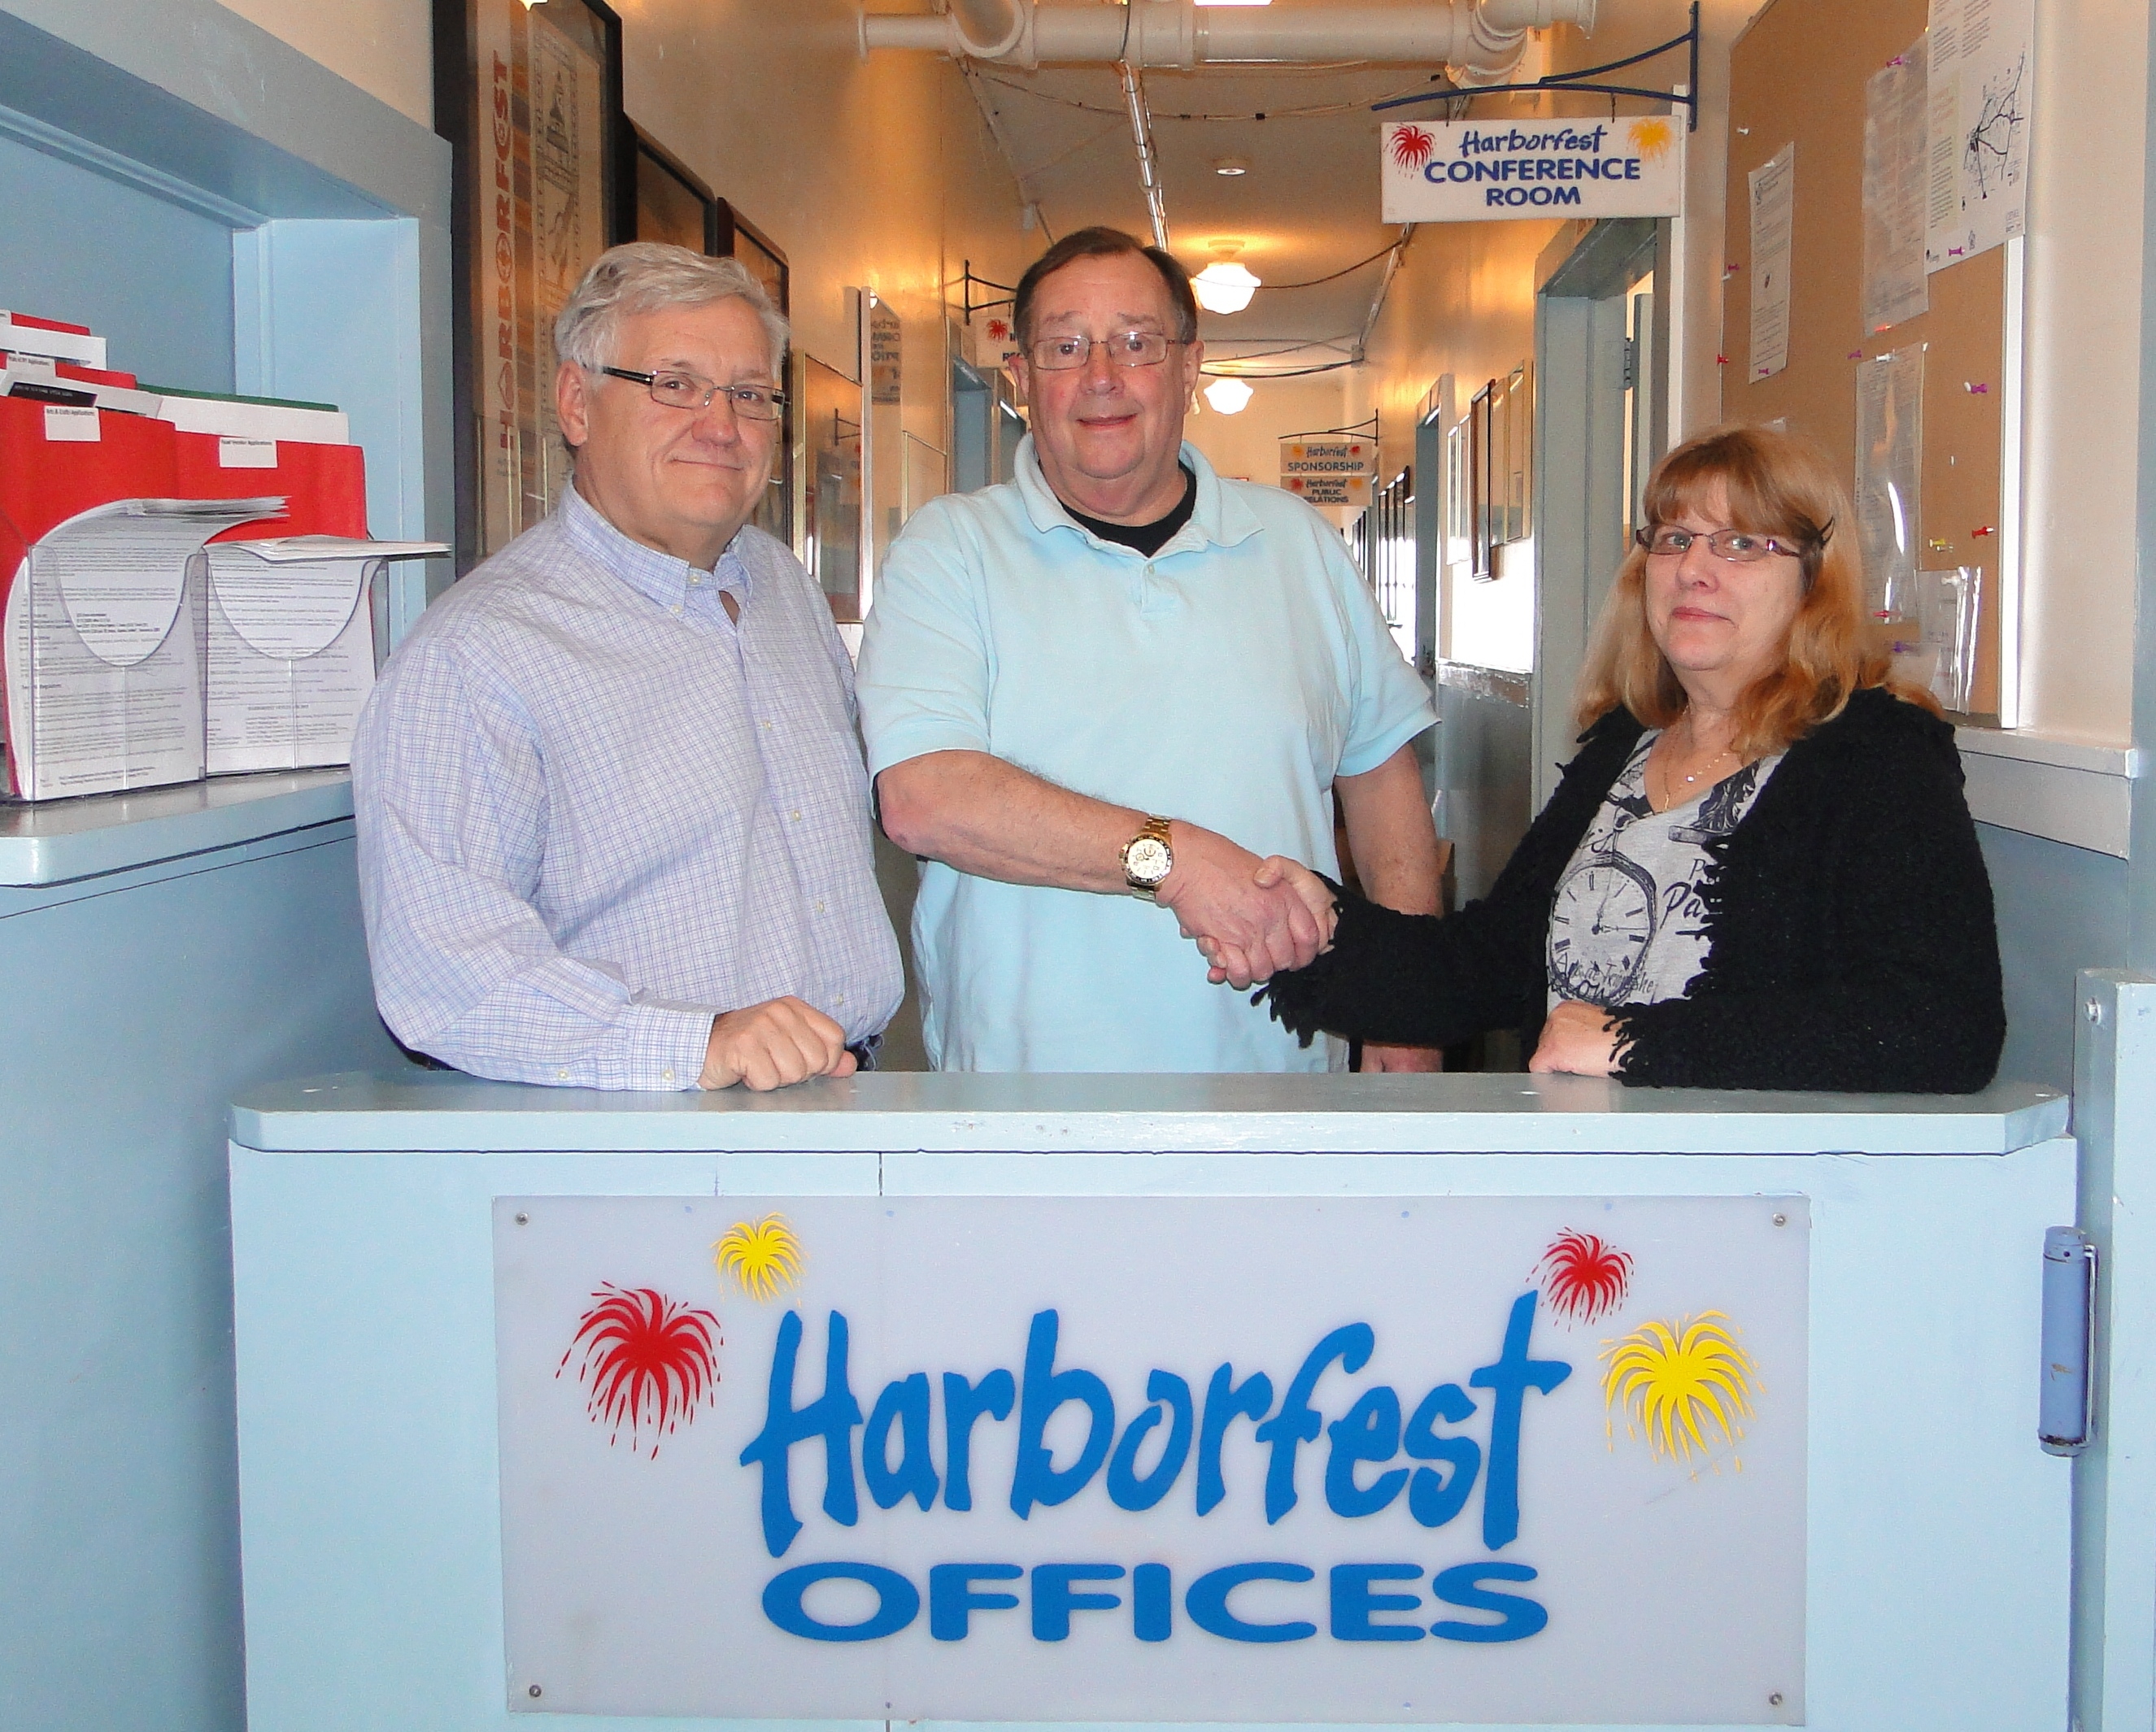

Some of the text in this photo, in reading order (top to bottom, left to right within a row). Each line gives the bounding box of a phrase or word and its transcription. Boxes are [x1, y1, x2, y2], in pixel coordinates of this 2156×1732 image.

[1459, 124, 1608, 158] Harborfest
[1423, 158, 1641, 184] CONFERENCE
[1485, 186, 1582, 207] ROOM
[1306, 445, 1348, 458] Harborfest
[1287, 462, 1364, 472] SPONSORSHIP
[739, 1290, 1573, 1558] Harborfest
[761, 1561, 1548, 1643] OFFICES
